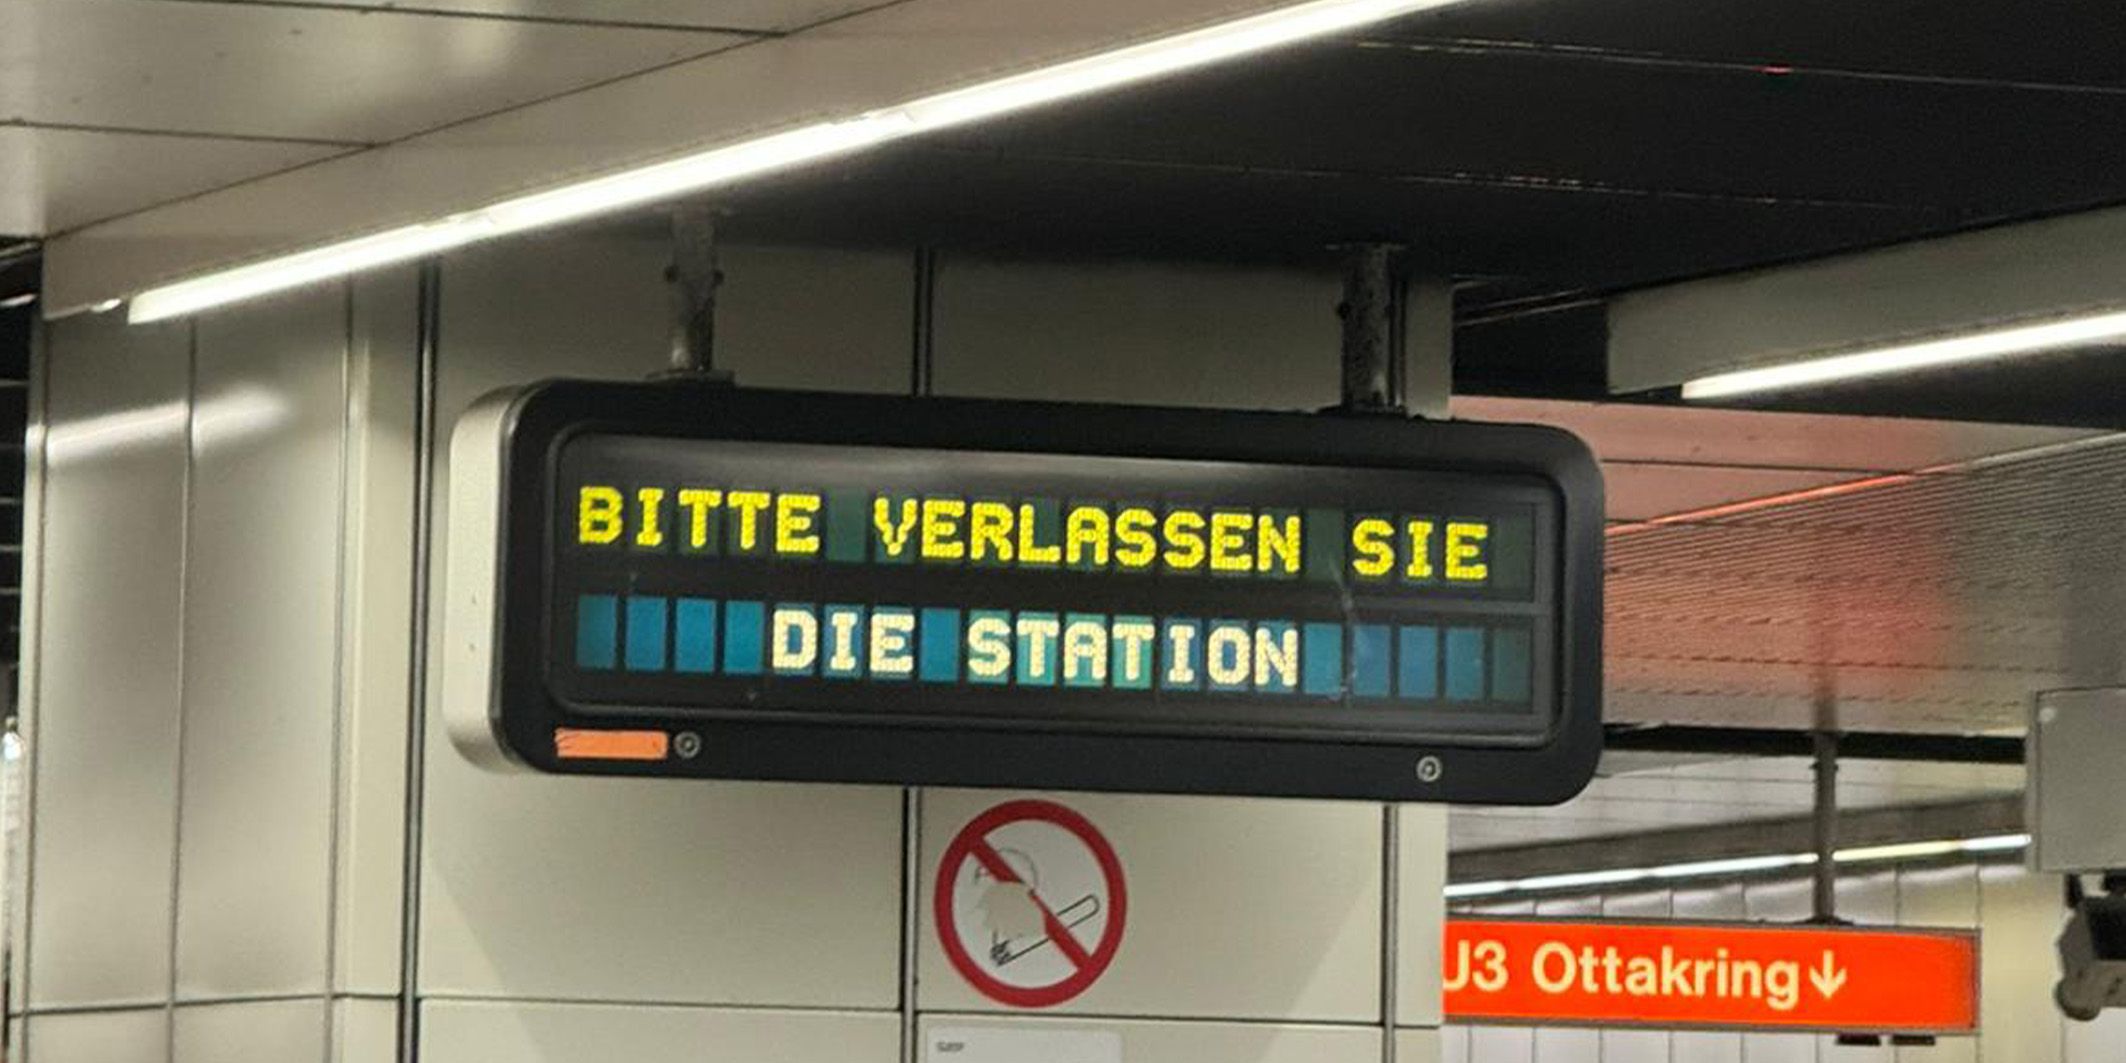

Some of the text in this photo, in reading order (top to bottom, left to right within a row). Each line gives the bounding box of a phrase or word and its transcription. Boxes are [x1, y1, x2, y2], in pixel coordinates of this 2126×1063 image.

[579, 486, 1488, 580] BITTE VERLASSEN SIE
[772, 609, 1298, 687] DIE STATION
[1532, 942, 1799, 1011] Ottakring
